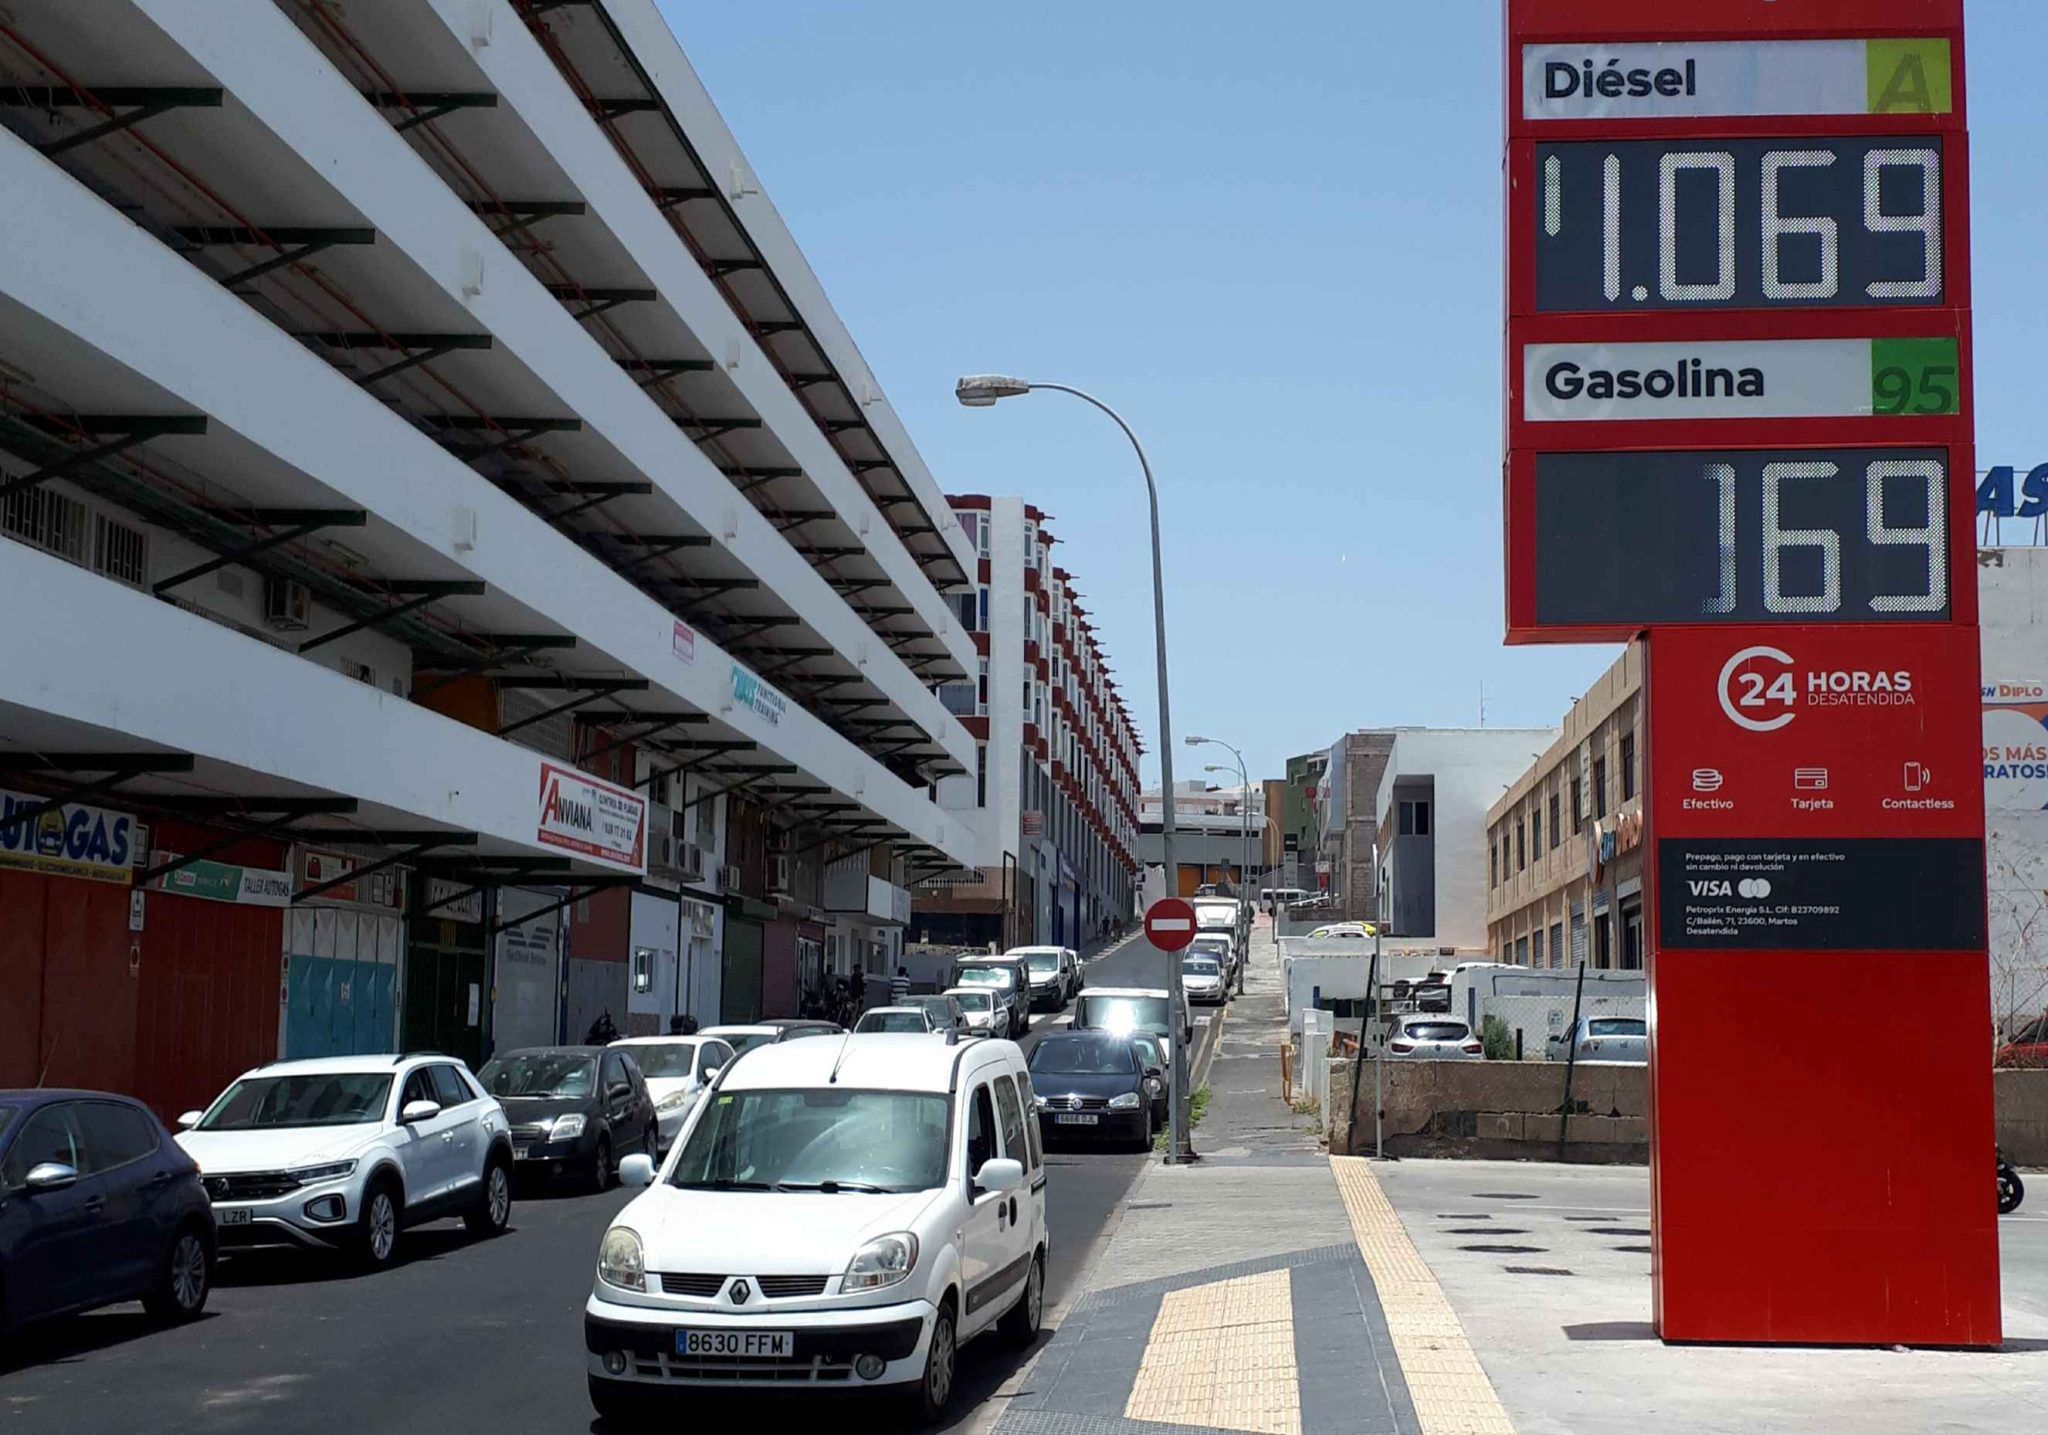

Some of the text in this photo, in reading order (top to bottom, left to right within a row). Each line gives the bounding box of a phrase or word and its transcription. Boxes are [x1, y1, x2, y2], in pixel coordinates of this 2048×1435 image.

[1544, 53, 1932, 113] Diésel A
[1545, 358, 1956, 415] Gasolina 95
[1738, 671, 1912, 706] 24 HORAS
[1808, 693, 1915, 706] DESATENDIDA
[2005, 743, 2047, 761] MÁS
[1683, 798, 1734, 809] Efectivo
[1790, 798, 1834, 811] Tarjeta
[1882, 798, 1954, 809] Contactless
[1686, 853, 1722, 862] Prepago,
[1763, 853, 1790, 862] tarjeta
[1811, 853, 1845, 861] efectivo
[1699, 863, 1729, 871] cambio
[1739, 863, 1784, 871] devolución
[1686, 880, 1732, 897] VISA
[1686, 906, 1723, 915] Petroprix
[1687, 927, 1738, 935] Desatendida
[223, 1210, 247, 1224] LZR
[688, 1333, 783, 1354] 8630 FFM
